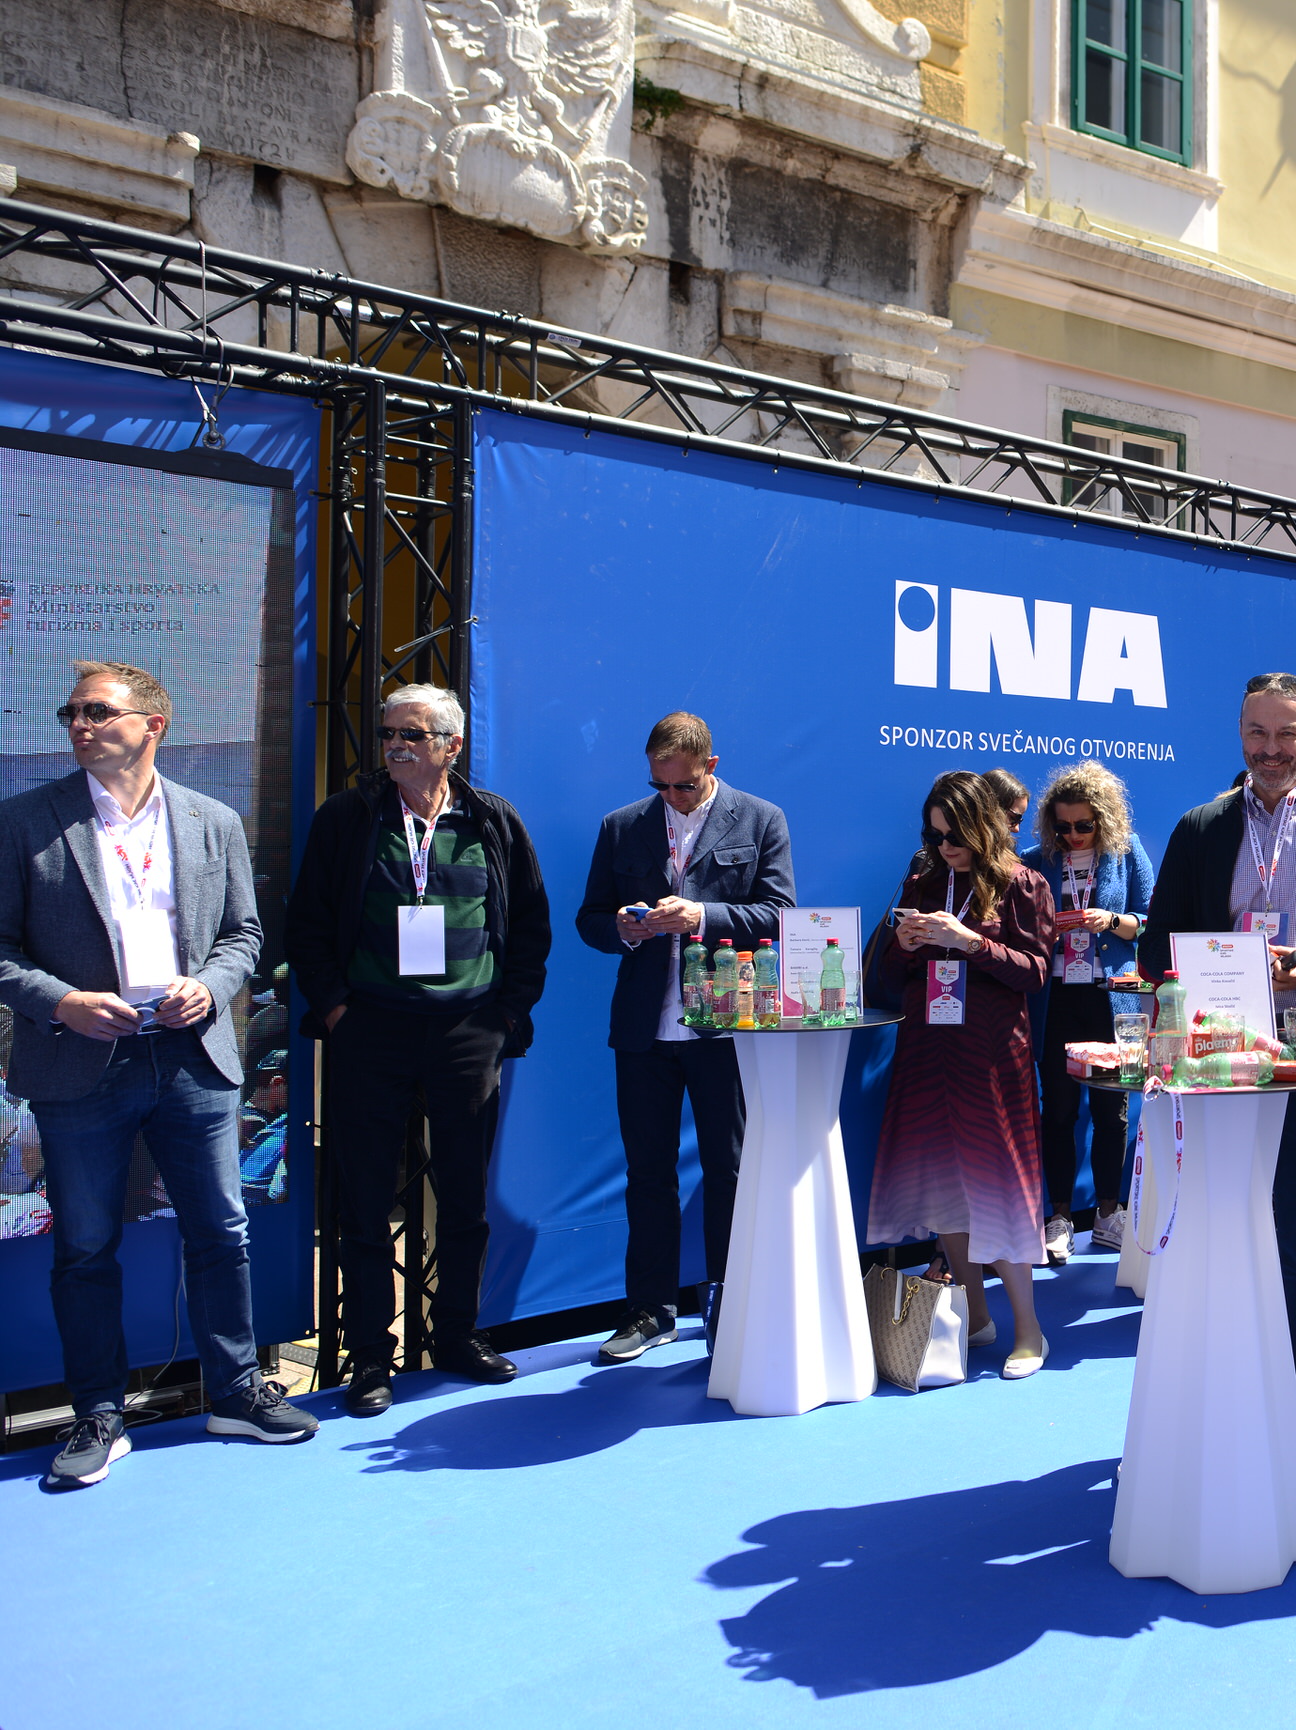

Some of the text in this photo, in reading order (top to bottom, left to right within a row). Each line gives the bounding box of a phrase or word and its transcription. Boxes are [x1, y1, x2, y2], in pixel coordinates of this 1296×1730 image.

[27, 600, 155, 614] Ministarstvo
[879, 725, 1176, 762] SPONZOR SVEČANOG OTVORENJA
